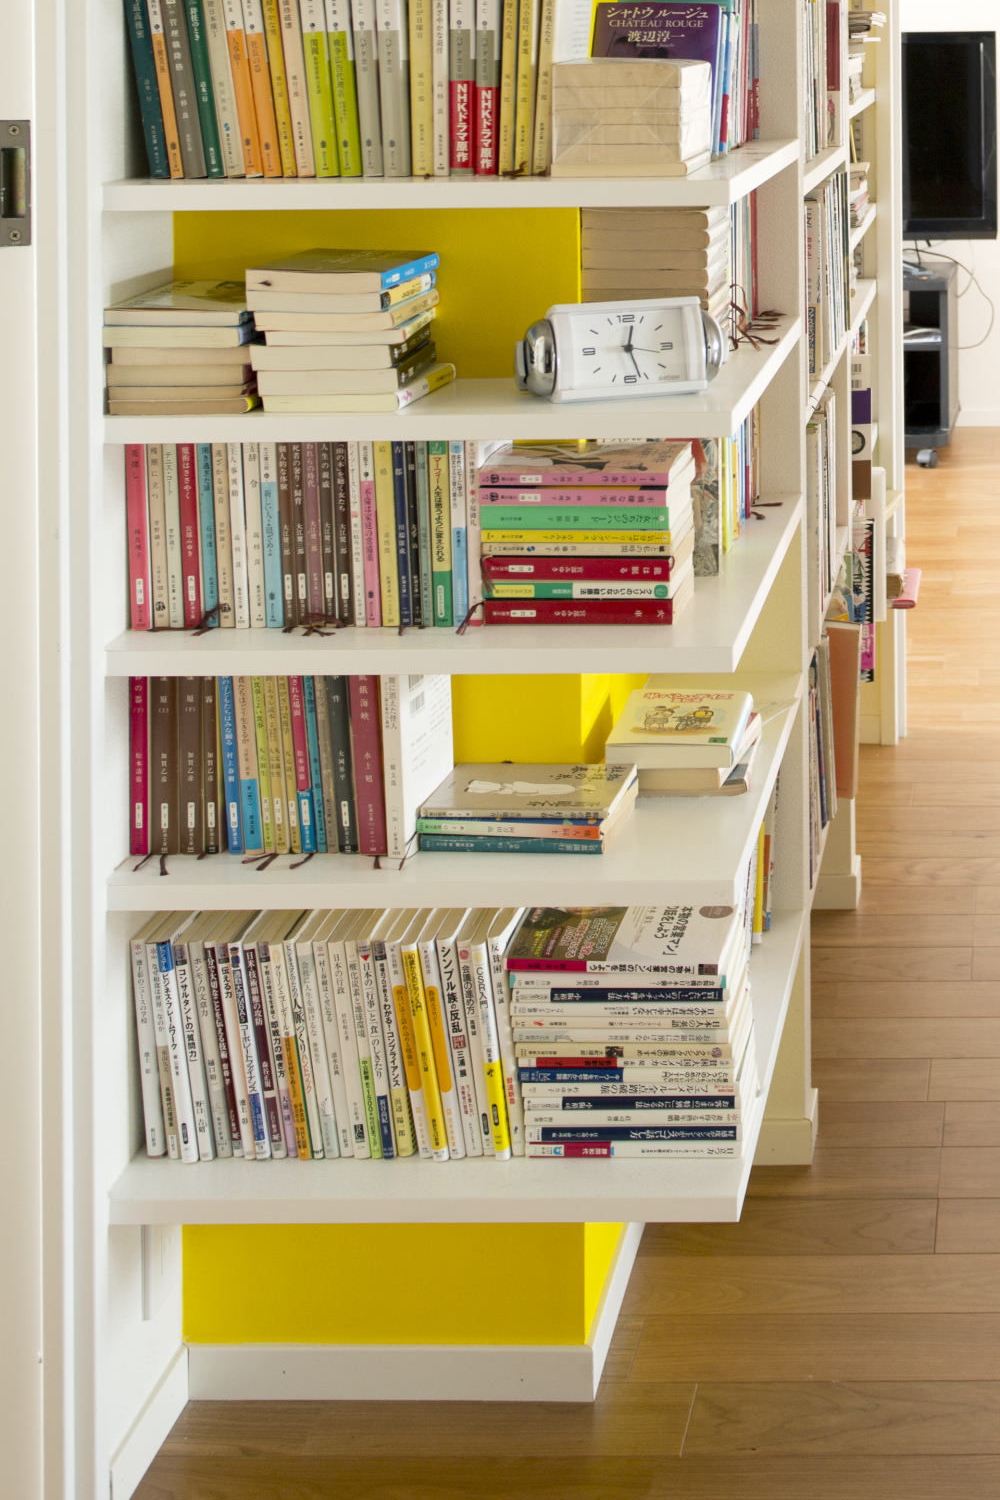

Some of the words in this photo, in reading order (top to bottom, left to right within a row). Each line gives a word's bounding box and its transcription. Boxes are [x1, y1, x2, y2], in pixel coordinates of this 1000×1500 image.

[665, 20, 704, 28] ROUGE
[627, 30, 685, 42] 渡辺淳一
[456, 84, 468, 162] NHKドラマ原作
[481, 90, 493, 168] NHKドラマ原作
[617, 314, 635, 322] 12
[660, 342, 673, 350] 3
[582, 348, 596, 356] 9
[624, 375, 637, 384] 6
[333, 953, 346, 995] 日本の行政
[220, 967, 233, 999] 伝える力
[441, 946, 462, 1033] シンプル族の反乱
[671, 1019, 720, 1028] 日本人の英語
